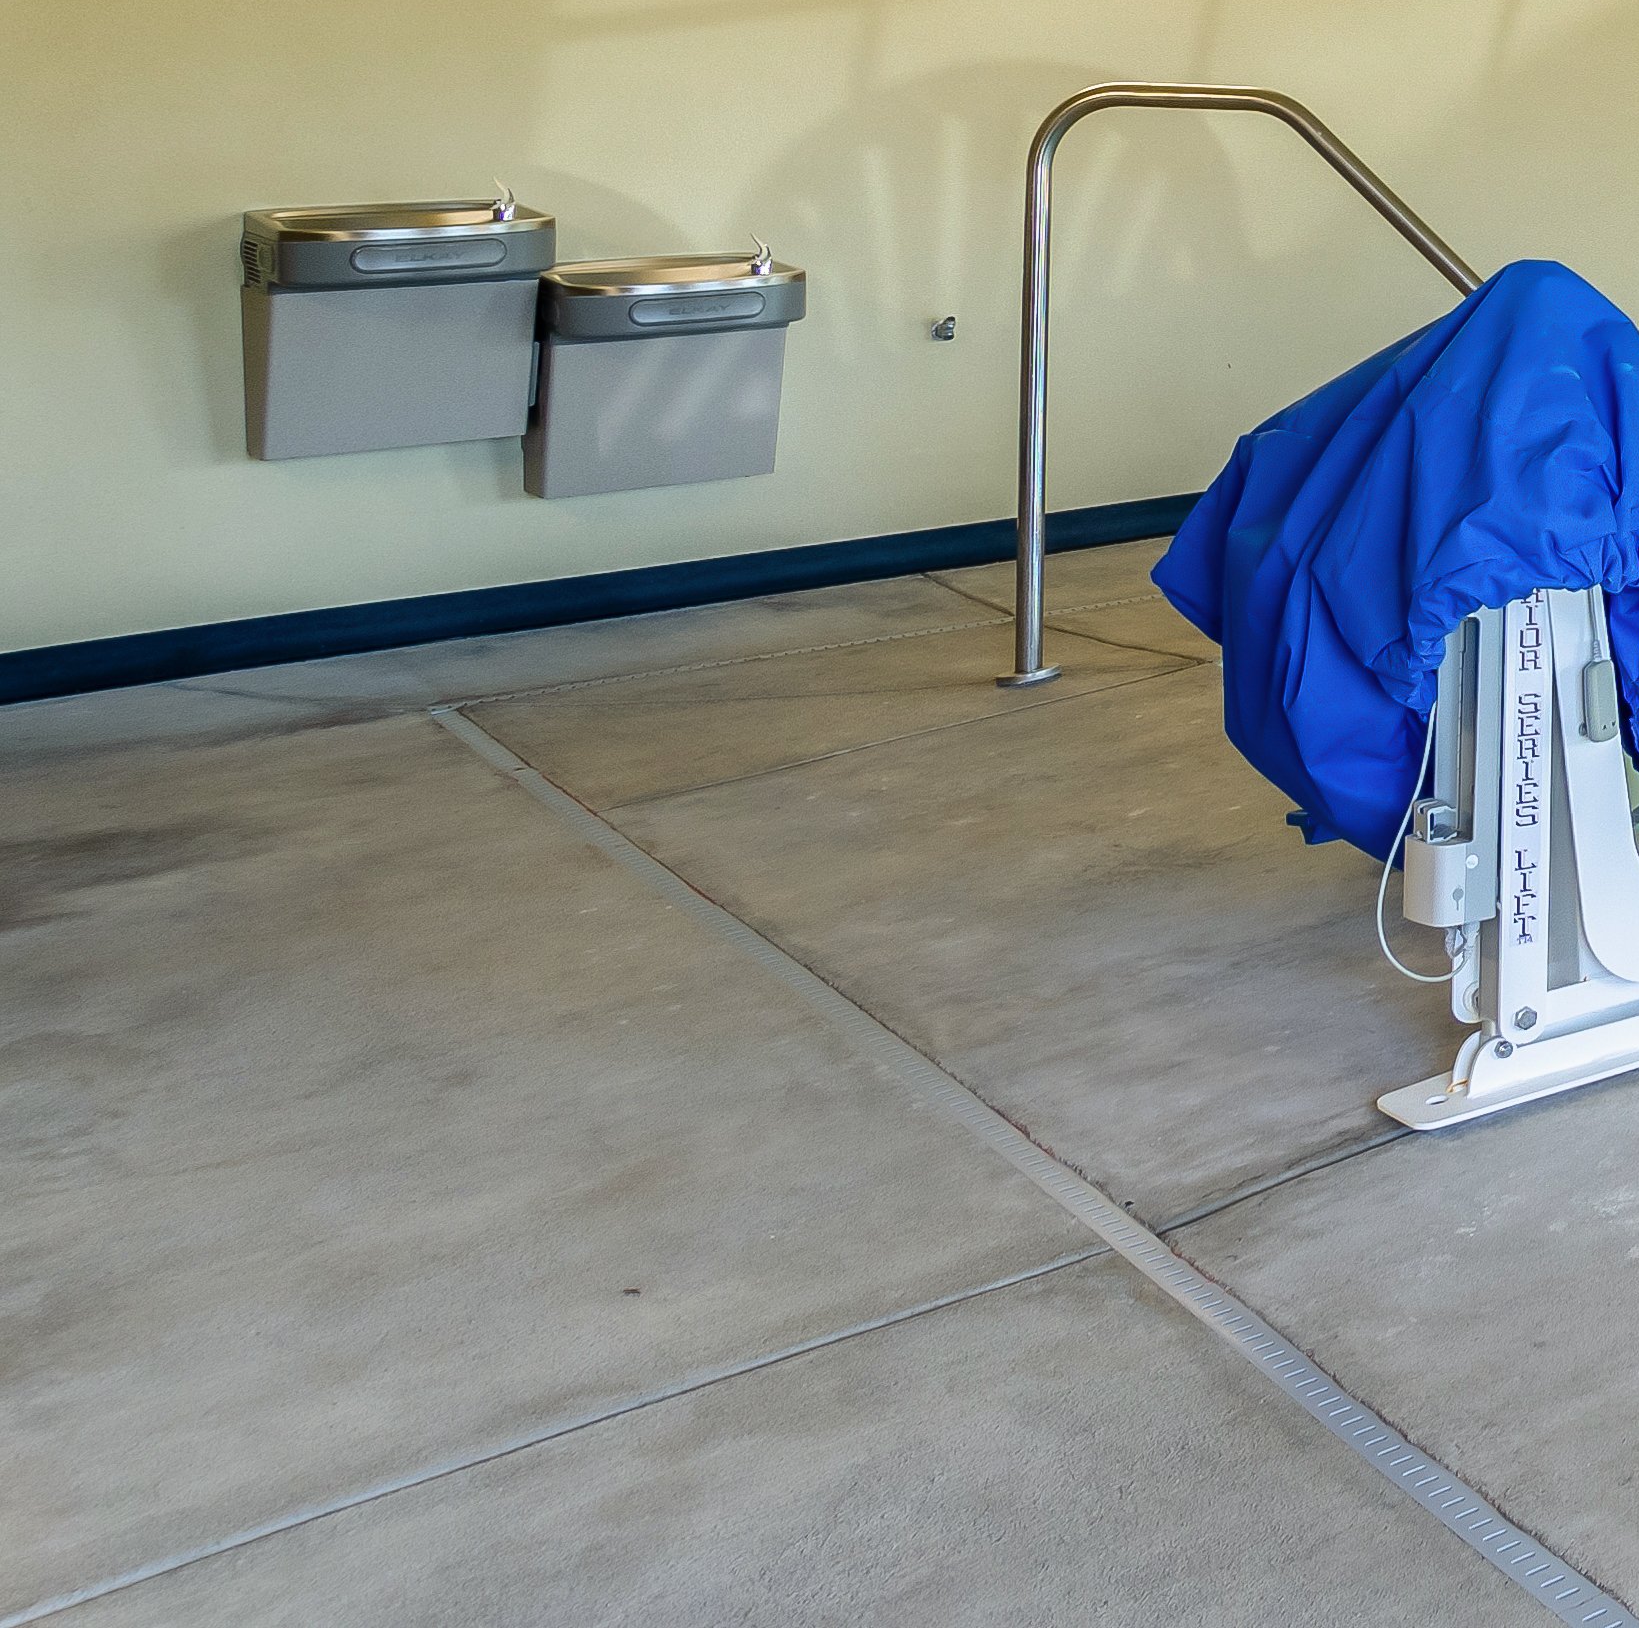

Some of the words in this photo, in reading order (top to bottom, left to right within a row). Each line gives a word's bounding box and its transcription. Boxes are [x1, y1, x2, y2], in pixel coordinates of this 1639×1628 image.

[395, 252, 466, 263] ELKAY
[1516, 693, 1541, 827] SERIES
[1513, 849, 1537, 937] LIFT
